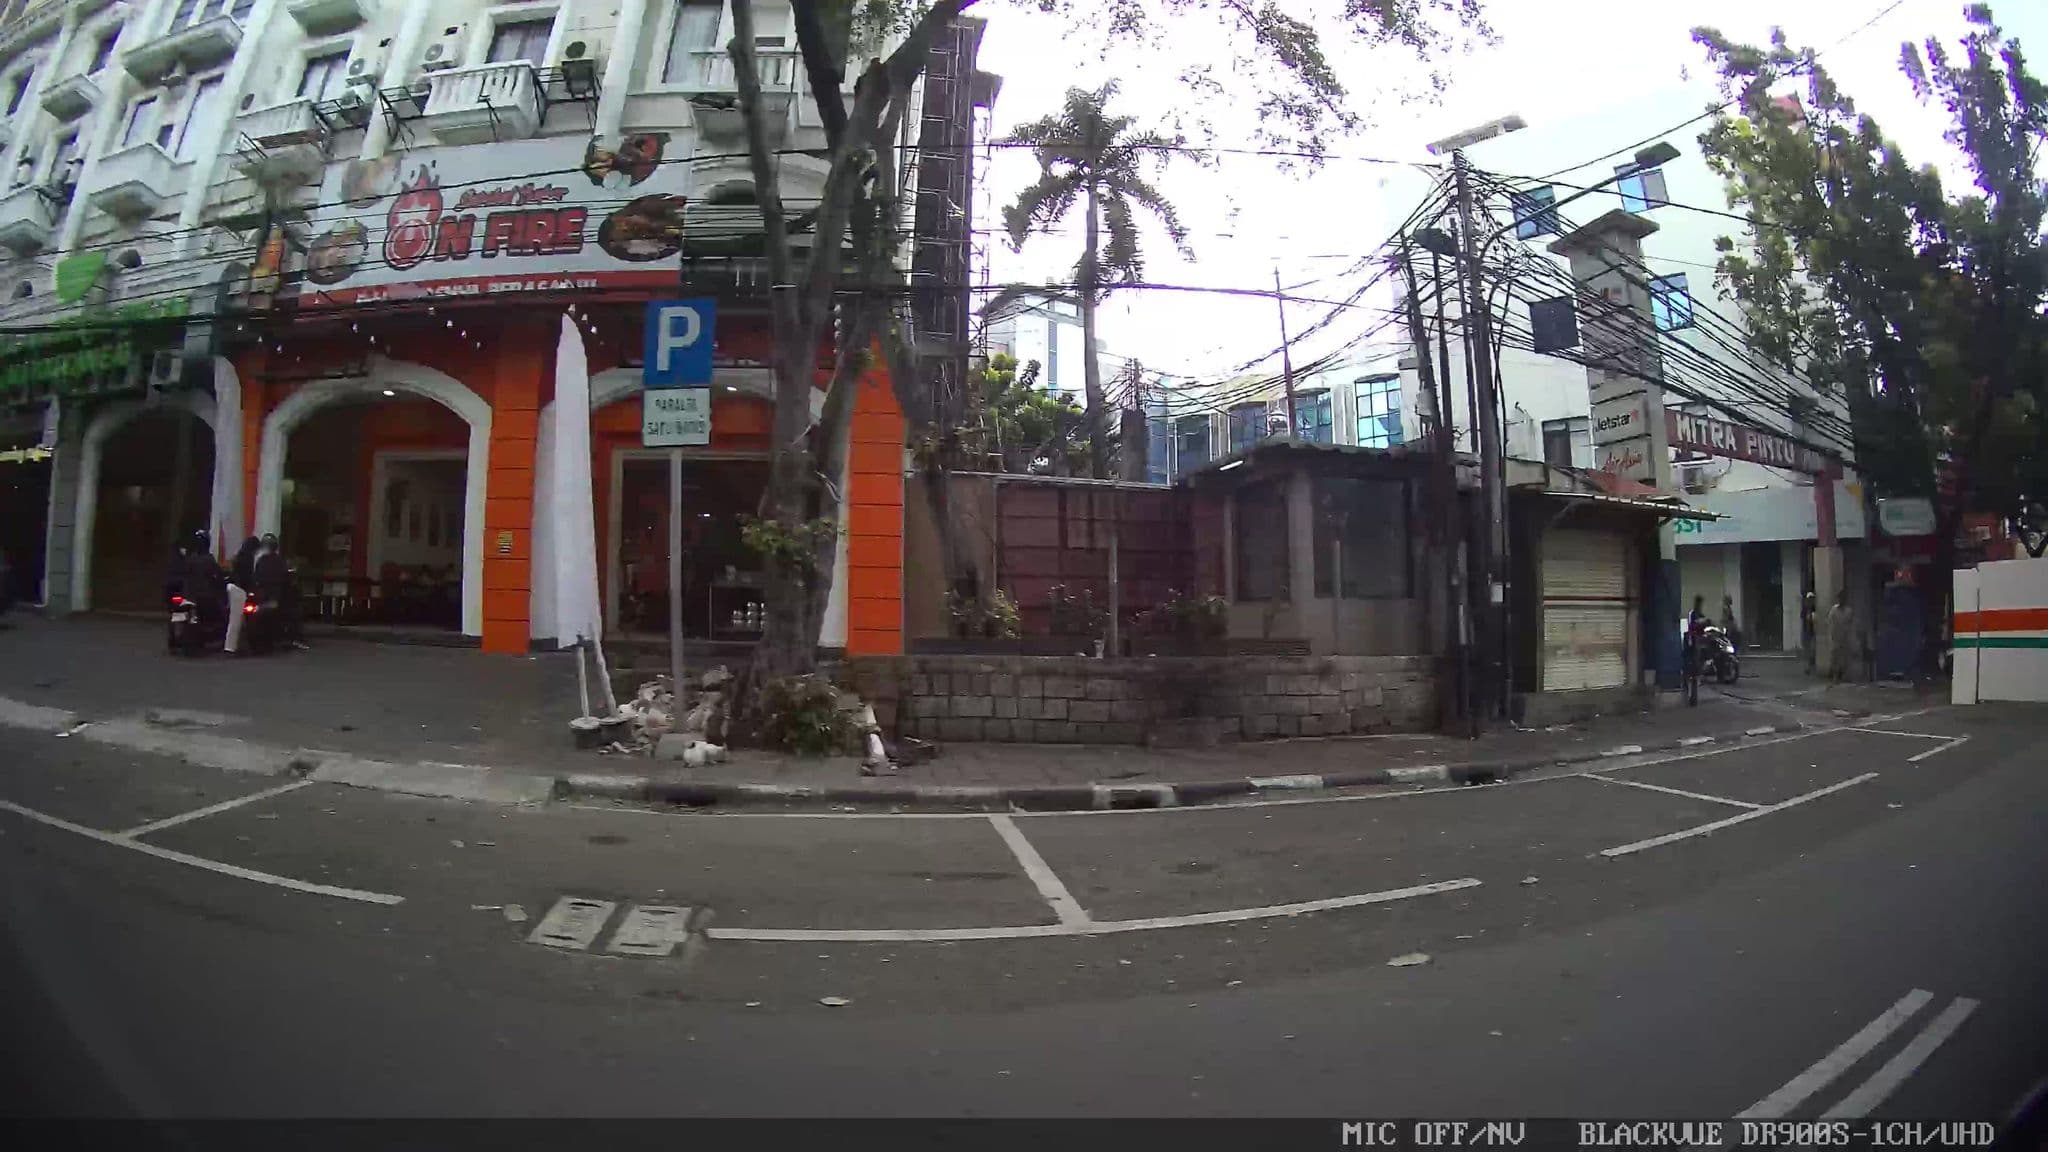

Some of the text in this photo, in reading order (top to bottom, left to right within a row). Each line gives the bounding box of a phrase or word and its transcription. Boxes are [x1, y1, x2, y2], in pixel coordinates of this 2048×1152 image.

[482, 206, 588, 258] FIRE
[656, 306, 700, 371] P
[1595, 413, 1632, 432] Jetstar
[1675, 412, 1737, 451] MITRA
[1746, 432, 1796, 465] PINTU
